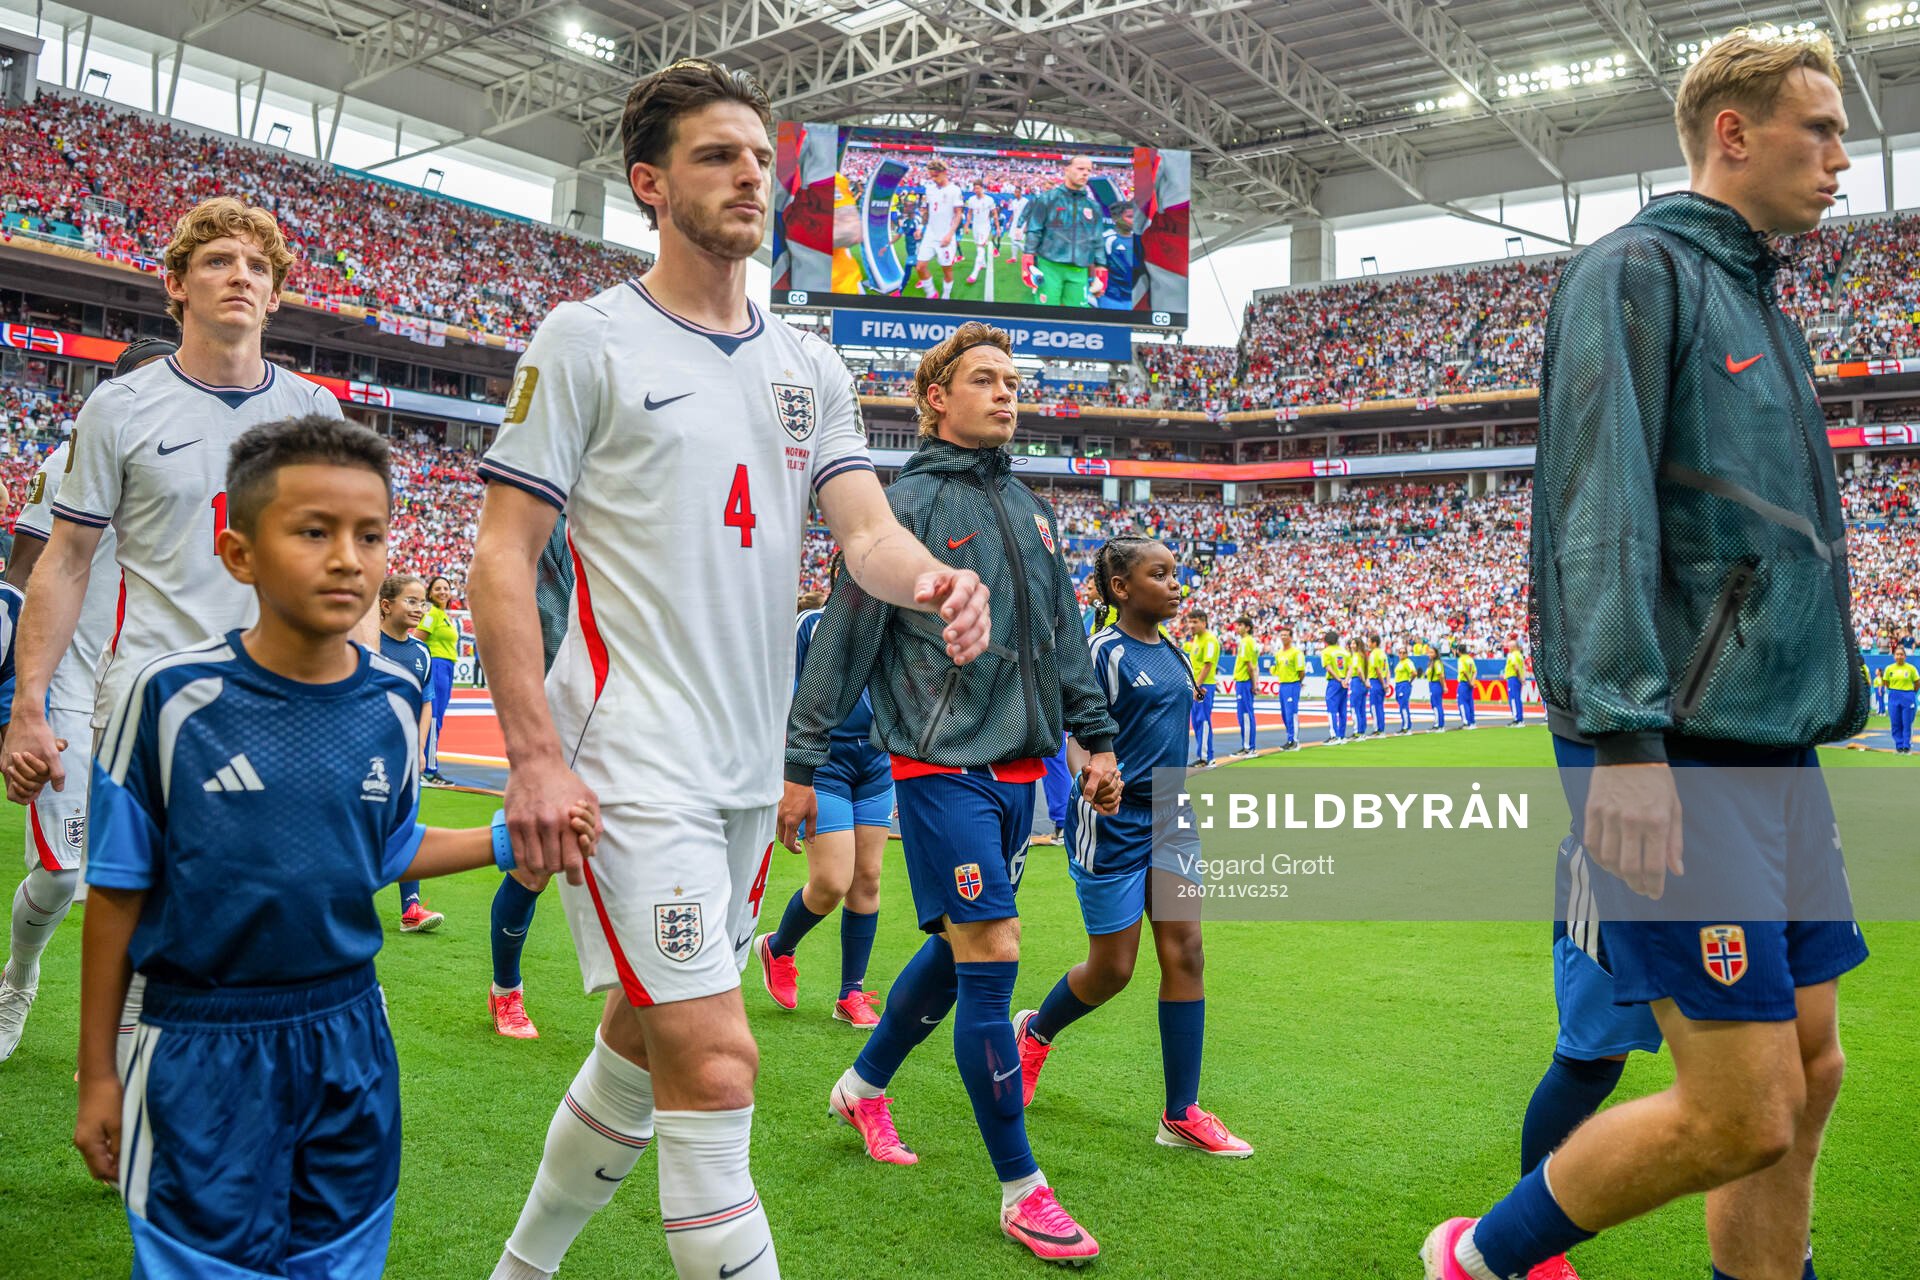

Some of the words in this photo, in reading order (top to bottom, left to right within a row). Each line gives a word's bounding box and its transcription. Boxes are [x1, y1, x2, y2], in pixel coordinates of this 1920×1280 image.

[791, 293, 806, 303] CC
[1154, 314, 1168, 324] CC
[861, 320, 907, 339] FIFA
[909, 323, 958, 341] WOR
[1032, 330, 1104, 350] 2026
[785, 447, 810, 459] NORWAY
[724, 463, 756, 548] 4
[748, 840, 775, 919] 4
